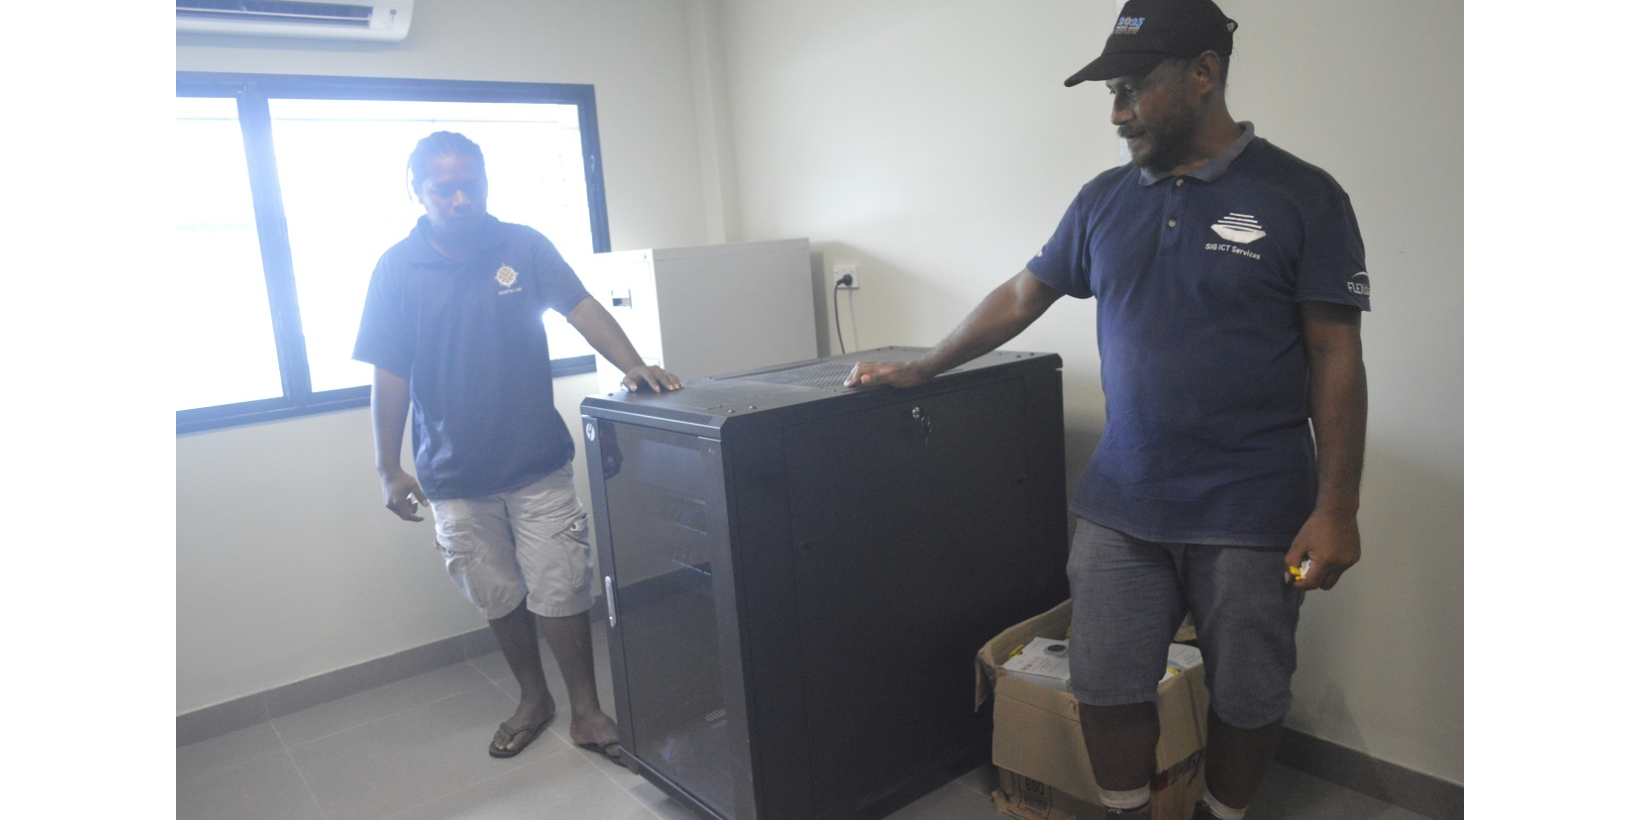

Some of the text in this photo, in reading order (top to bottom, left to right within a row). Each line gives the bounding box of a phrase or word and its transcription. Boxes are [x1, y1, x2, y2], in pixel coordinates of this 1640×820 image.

[1205, 243, 1261, 260] SIG ICT Services
